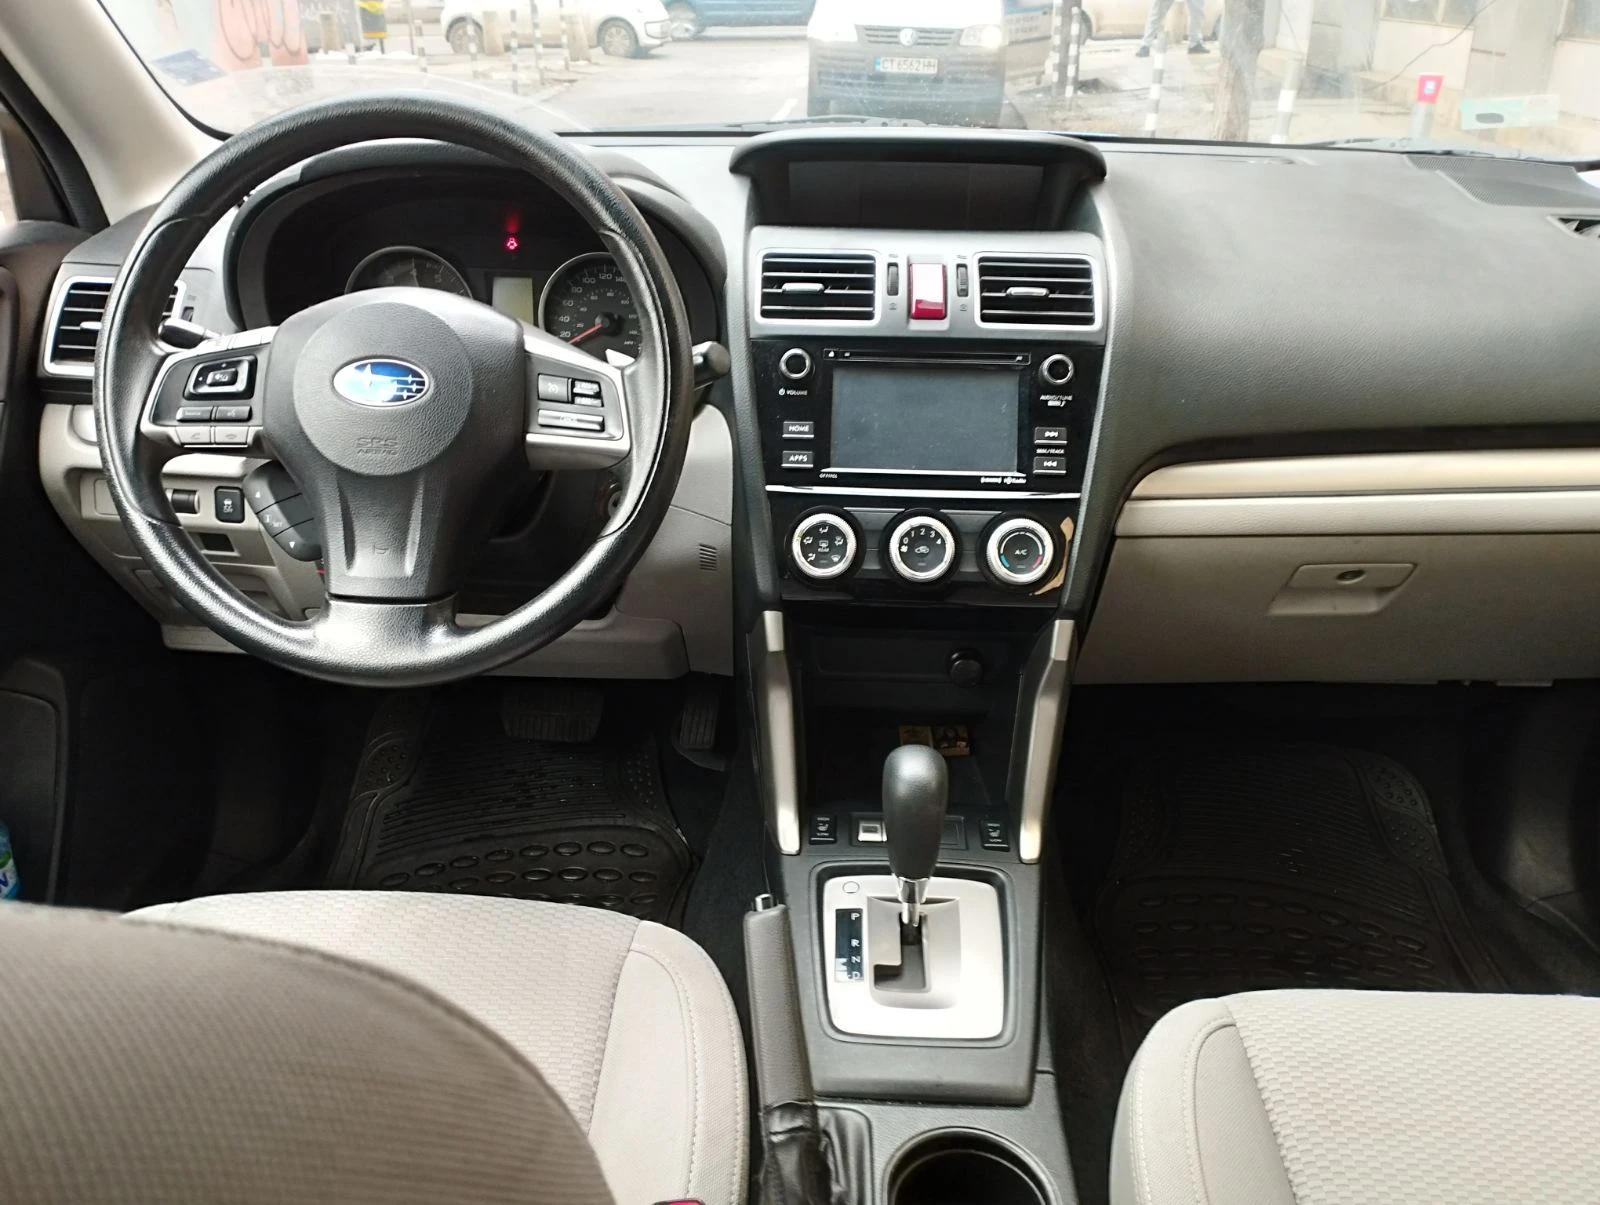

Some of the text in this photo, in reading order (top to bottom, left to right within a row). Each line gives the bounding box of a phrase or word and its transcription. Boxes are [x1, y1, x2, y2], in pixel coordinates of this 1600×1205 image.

[559, 315, 570, 323] 40
[788, 424, 810, 432] HOME
[788, 454, 808, 462] APPS
[911, 530, 915, 538] 1
[919, 528, 926, 536] 2
[929, 530, 936, 538] 3
[903, 537, 909, 545] 0
[851, 912, 860, 920] P
[851, 938, 860, 948] R
[851, 955, 861, 963] N
[852, 971, 860, 980] D
